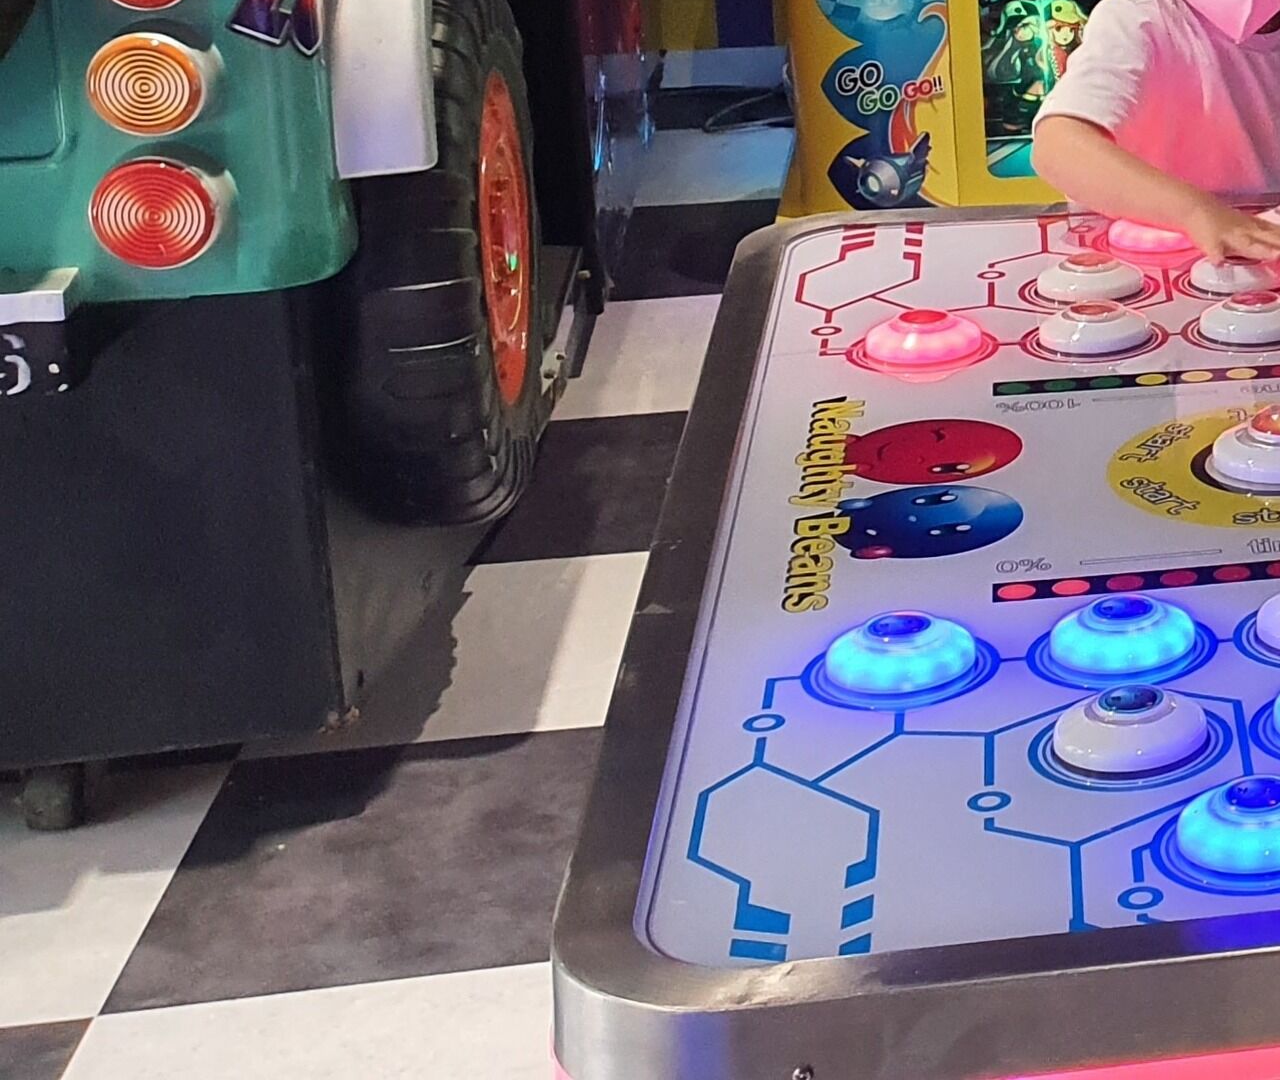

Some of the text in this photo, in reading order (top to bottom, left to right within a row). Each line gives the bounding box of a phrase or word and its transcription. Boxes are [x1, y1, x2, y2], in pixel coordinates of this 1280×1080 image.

[836, 60, 883, 96] GO
[857, 75, 944, 115] GO GO!!
[995, 397, 1081, 416] 100%
[1118, 423, 1193, 463] start
[781, 396, 866, 614] Naughty Beans
[1121, 476, 1200, 515] start
[995, 556, 1053, 575] 0%
